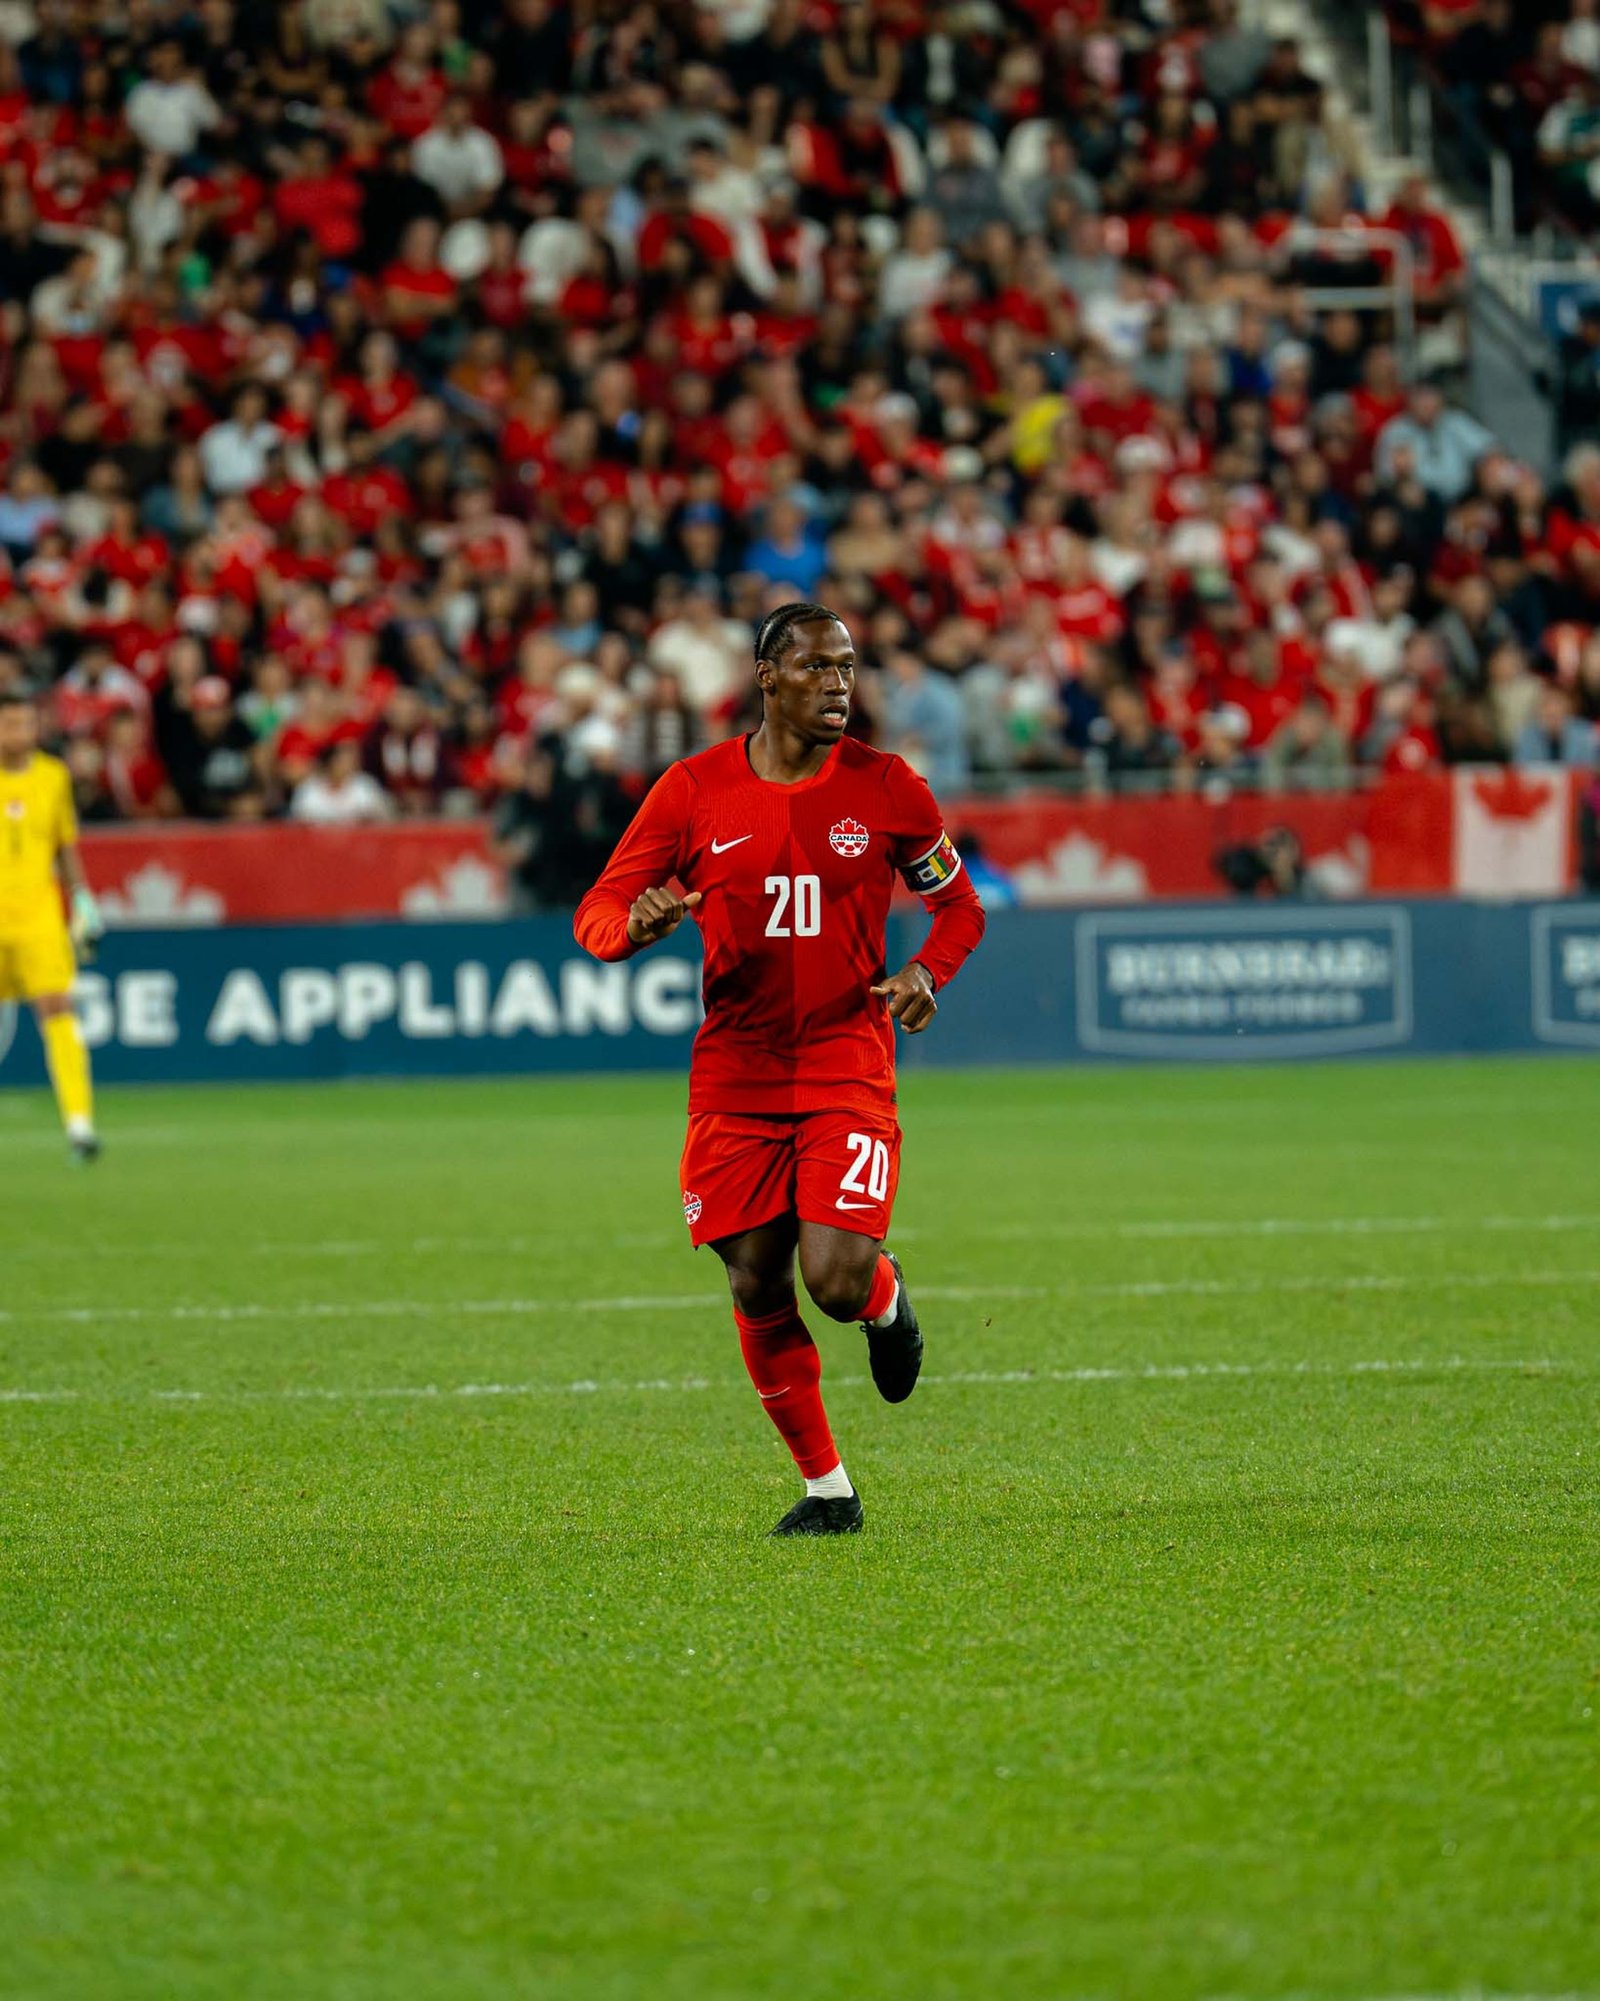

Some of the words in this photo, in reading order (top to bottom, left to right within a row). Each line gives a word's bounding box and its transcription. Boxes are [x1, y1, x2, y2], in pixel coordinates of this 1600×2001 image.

[764, 874, 821, 937] 20
[206, 956, 703, 1044] APPLIANC
[840, 1132, 889, 1202] 20
